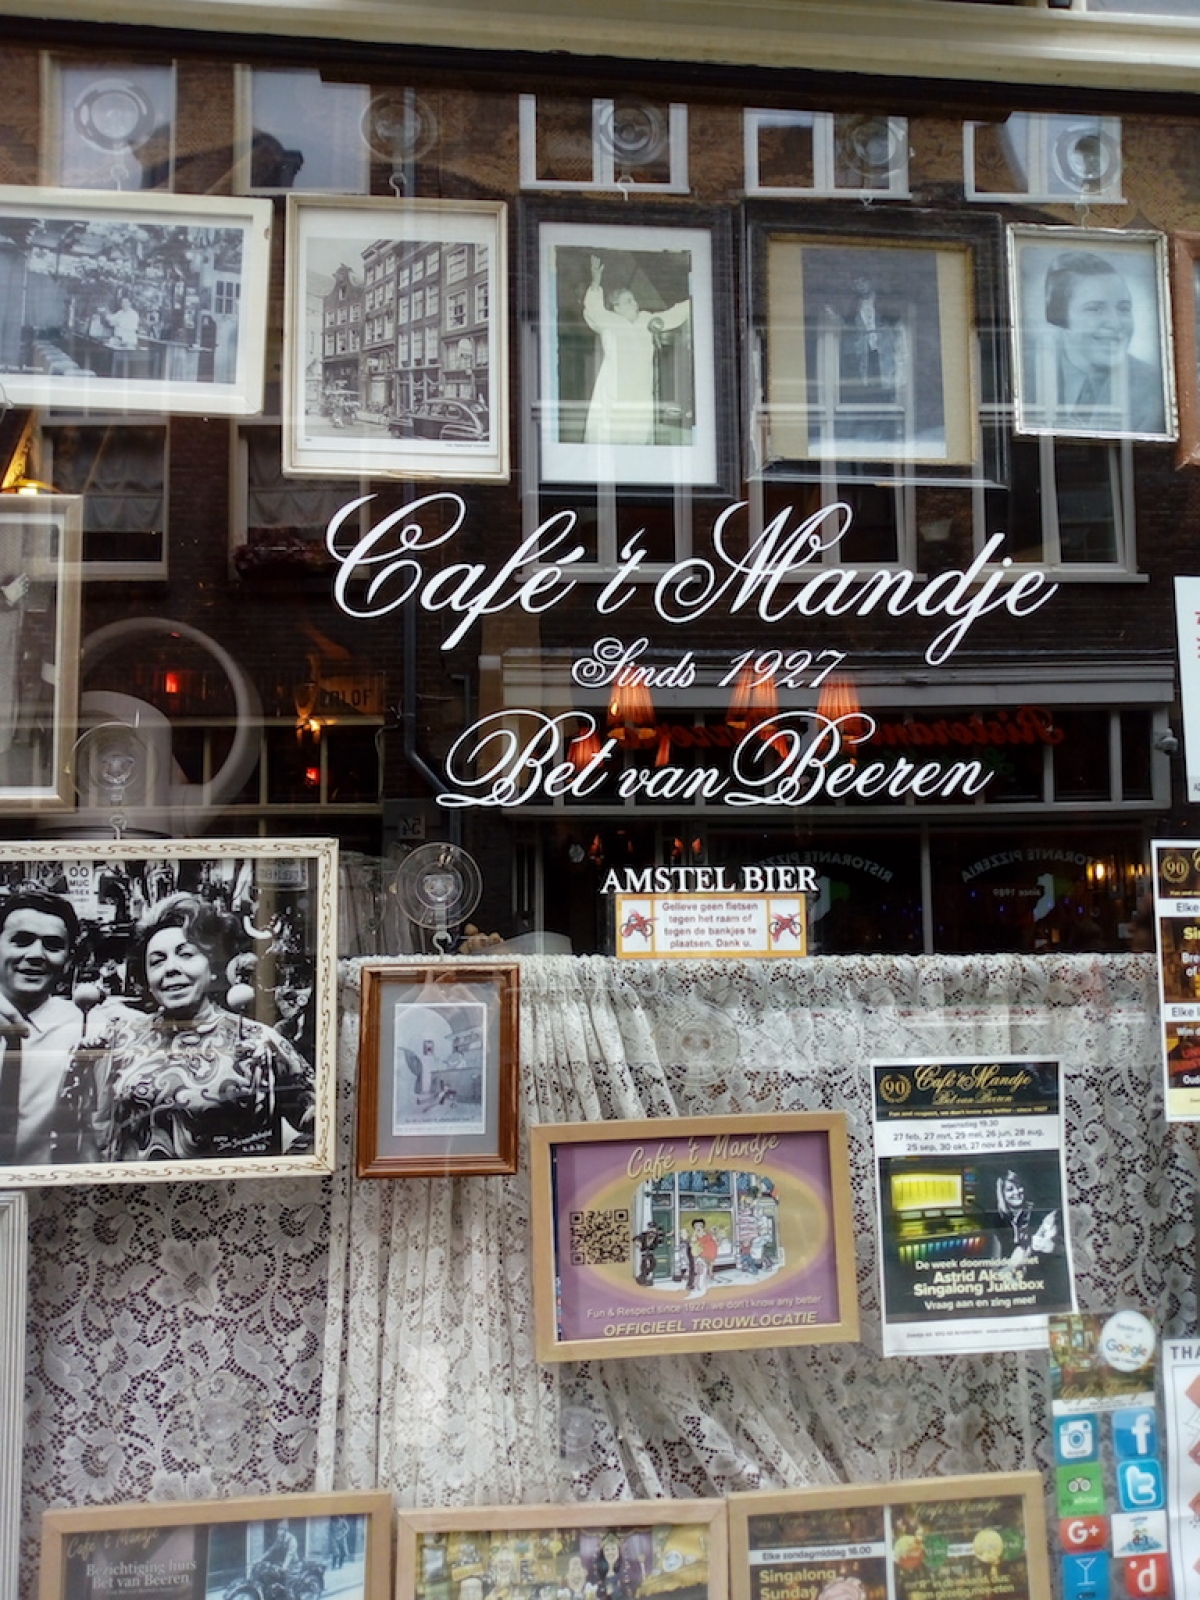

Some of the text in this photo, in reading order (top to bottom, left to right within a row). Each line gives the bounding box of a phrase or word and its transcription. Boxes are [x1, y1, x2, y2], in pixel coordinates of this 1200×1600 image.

[326, 491, 584, 650] Café
[654, 501, 1058, 666] Mandje
[571, 636, 846, 689] Sinds 1927
[435, 710, 994, 808] Bet van Beeren
[1167, 862, 1185, 875] 90
[600, 867, 820, 893] AMSTEL BIER
[662, 902, 759, 913] Gelieve geen fietsen
[1176, 902, 1199, 913] Elke
[668, 914, 753, 925] tegen het raam of
[663, 926, 757, 937] tegen de bankjes te
[715, 938, 740, 948] Dank
[1172, 1006, 1195, 1018] Elke
[885, 1080, 906, 1095] 90
[893, 1133, 904, 1141] 27
[924, 1132, 935, 1140] 27
[985, 1130, 996, 1138] 26
[1005, 1140, 1016, 1148] 26
[1017, 1139, 1032, 1147] dec
[627, 1142, 676, 1182] Café
[707, 1133, 781, 1165] Mandje
[915, 1260, 930, 1270] De
[931, 1259, 959, 1270] week
[933, 1269, 976, 1284] Astrid
[913, 1279, 1045, 1298] Singalong Jukebox
[587, 1308, 606, 1319] Fun
[607, 1307, 615, 1318] &
[616, 1304, 656, 1319] Respect
[657, 1303, 682, 1314] since
[711, 1302, 724, 1311] we
[751, 1298, 775, 1309] know
[776, 1297, 793, 1308] any
[924, 1300, 954, 1311] Vraag
[955, 1301, 974, 1309] aan
[976, 1300, 989, 1308] en
[990, 1297, 1012, 1309] zing
[603, 1310, 818, 1337] OFFICIEEL TROUWLOCATIE
[1105, 1338, 1147, 1358] Google
[762, 1552, 781, 1561] Elke
[782, 1547, 846, 1560] zondagmiddag
[86, 1559, 197, 1577] Bezichtiging huis
[92, 1573, 190, 1590] Bet van Beeren
[759, 1568, 837, 1585] Singalong
[760, 1585, 819, 1600] Sunday
